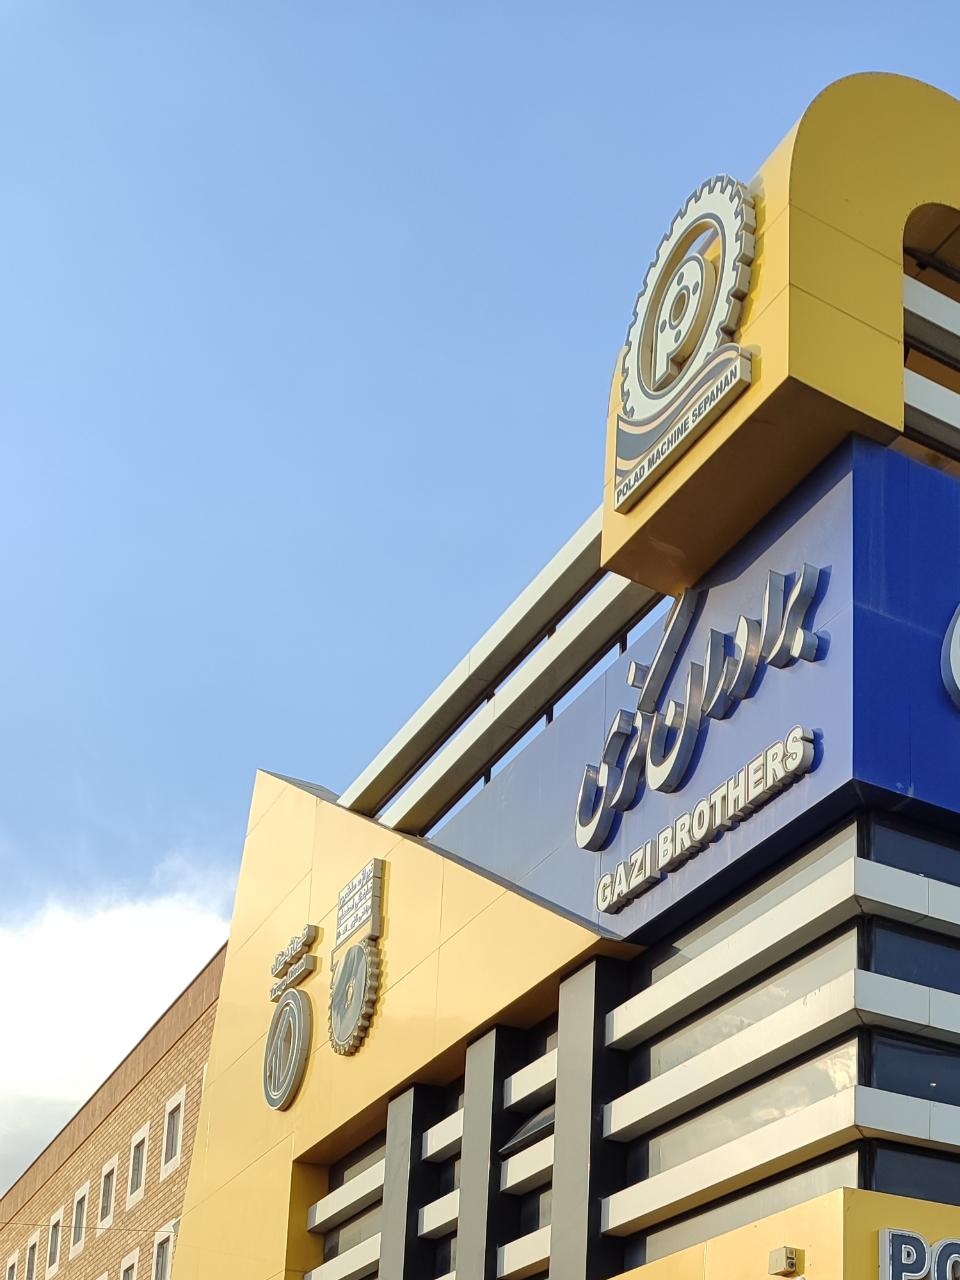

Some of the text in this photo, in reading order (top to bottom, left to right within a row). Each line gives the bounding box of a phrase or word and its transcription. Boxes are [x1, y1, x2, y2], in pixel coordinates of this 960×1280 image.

[616, 365, 738, 505] POLAD MACHINE SEPAHAN
[596, 724, 815, 914] GAZI BROTHERS
